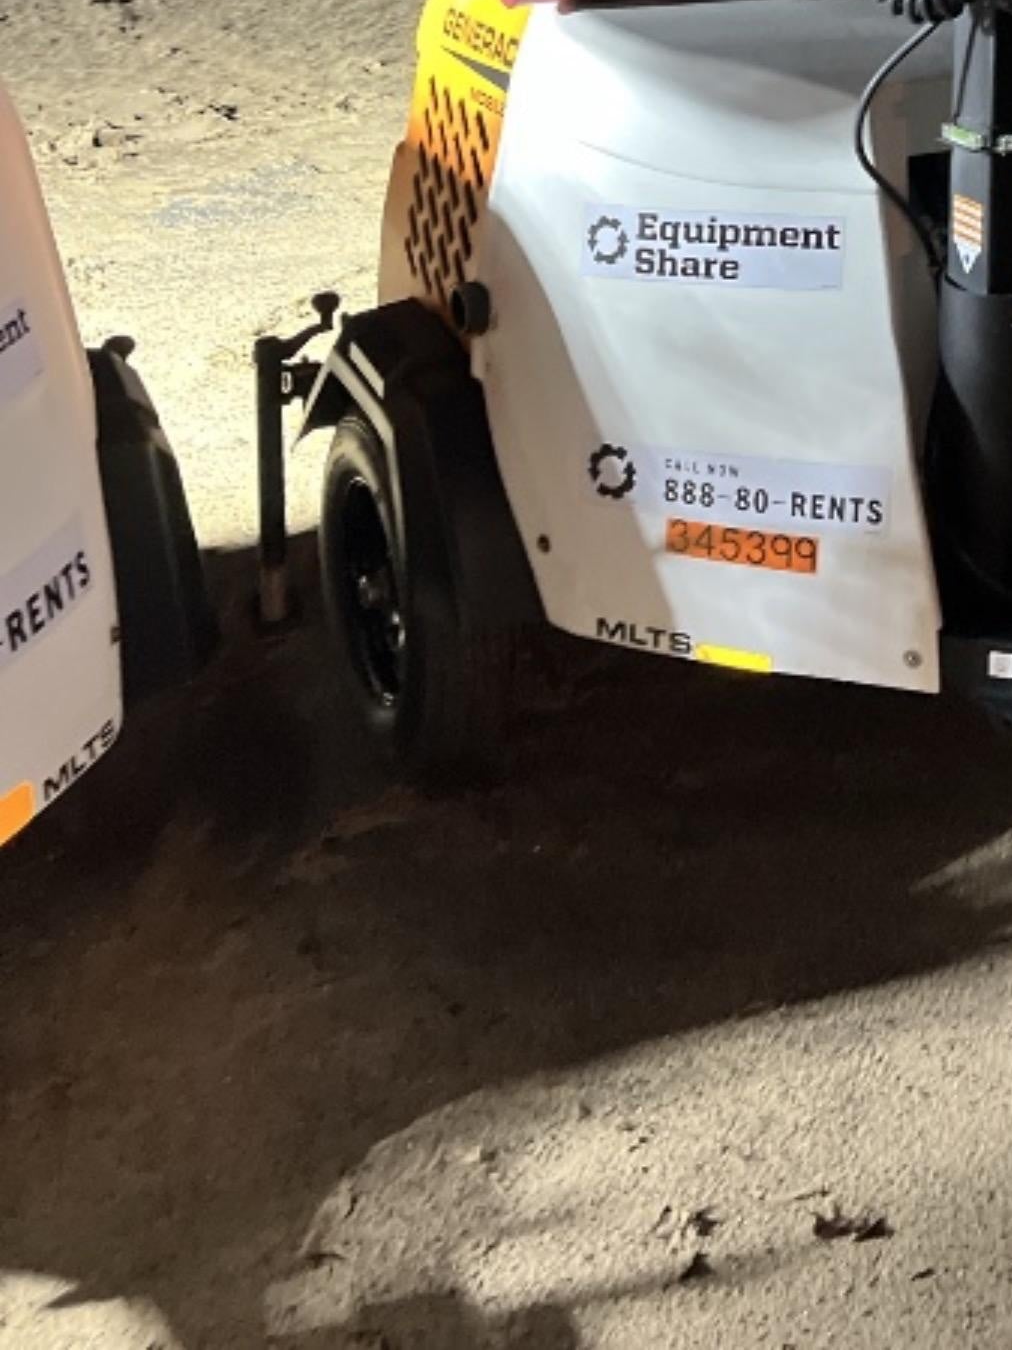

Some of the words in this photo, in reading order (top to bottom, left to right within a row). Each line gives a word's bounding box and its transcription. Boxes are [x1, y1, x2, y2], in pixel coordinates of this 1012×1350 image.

[636, 213, 841, 251] Equipment
[635, 248, 740, 280] Share
[664, 478, 884, 526] 888-80-RENTS
[668, 518, 818, 572] 345399
[596, 617, 692, 654] MLTS
[43, 718, 114, 801] MLTS
